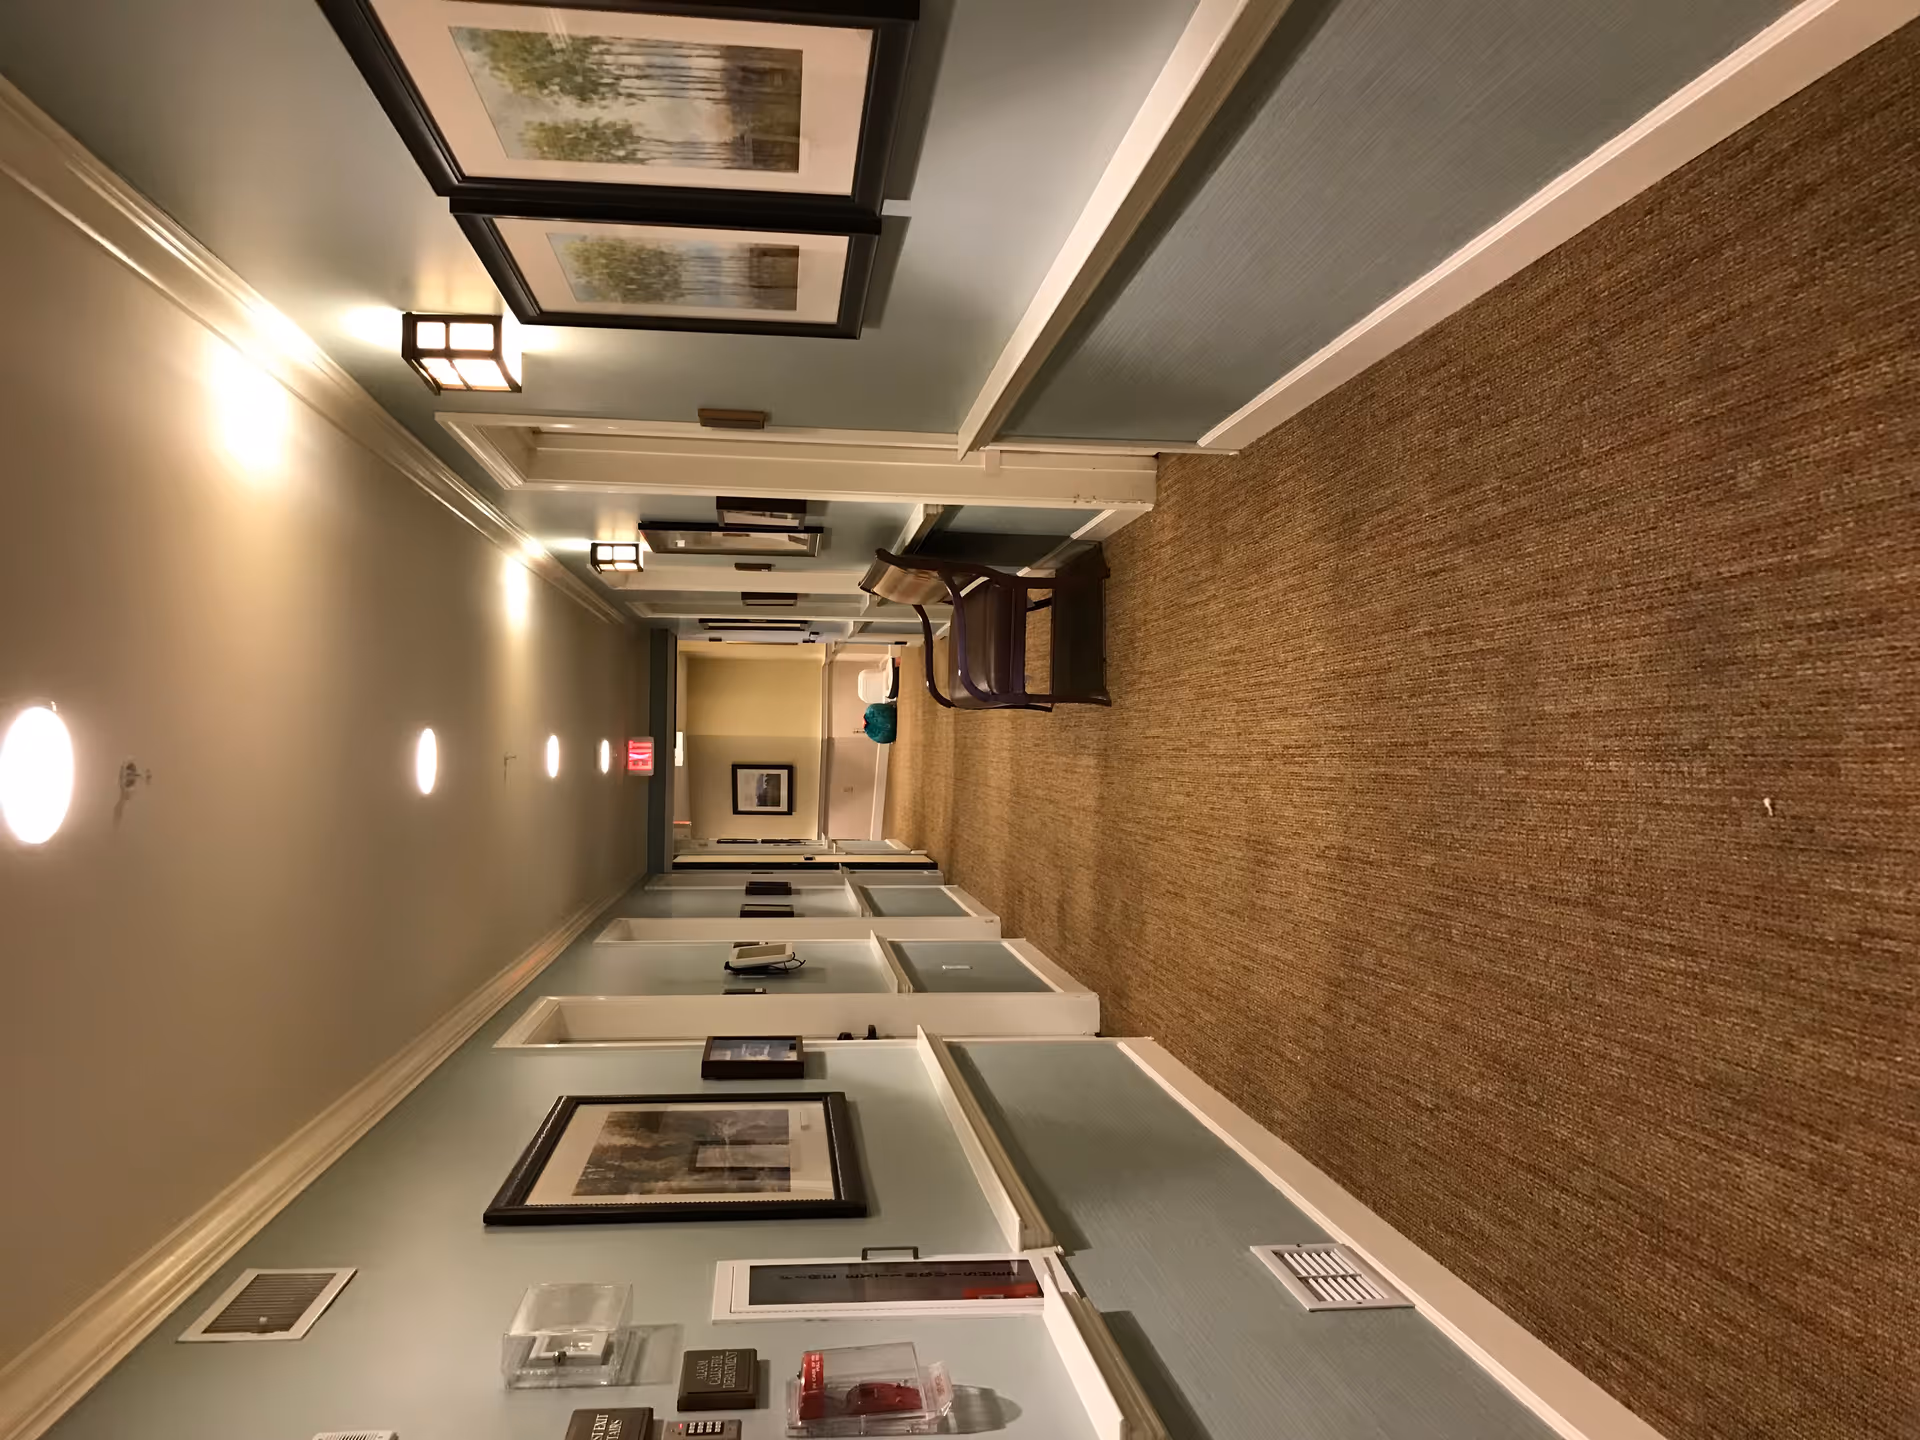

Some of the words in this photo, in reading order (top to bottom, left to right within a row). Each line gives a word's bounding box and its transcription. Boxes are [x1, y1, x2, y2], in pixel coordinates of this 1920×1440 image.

[628, 740, 652, 770] EXIT
[696, 1360, 708, 1380] ALARM
[723, 1352, 737, 1388] DEPARTMENT
[593, 1414, 609, 1430] EXIT
